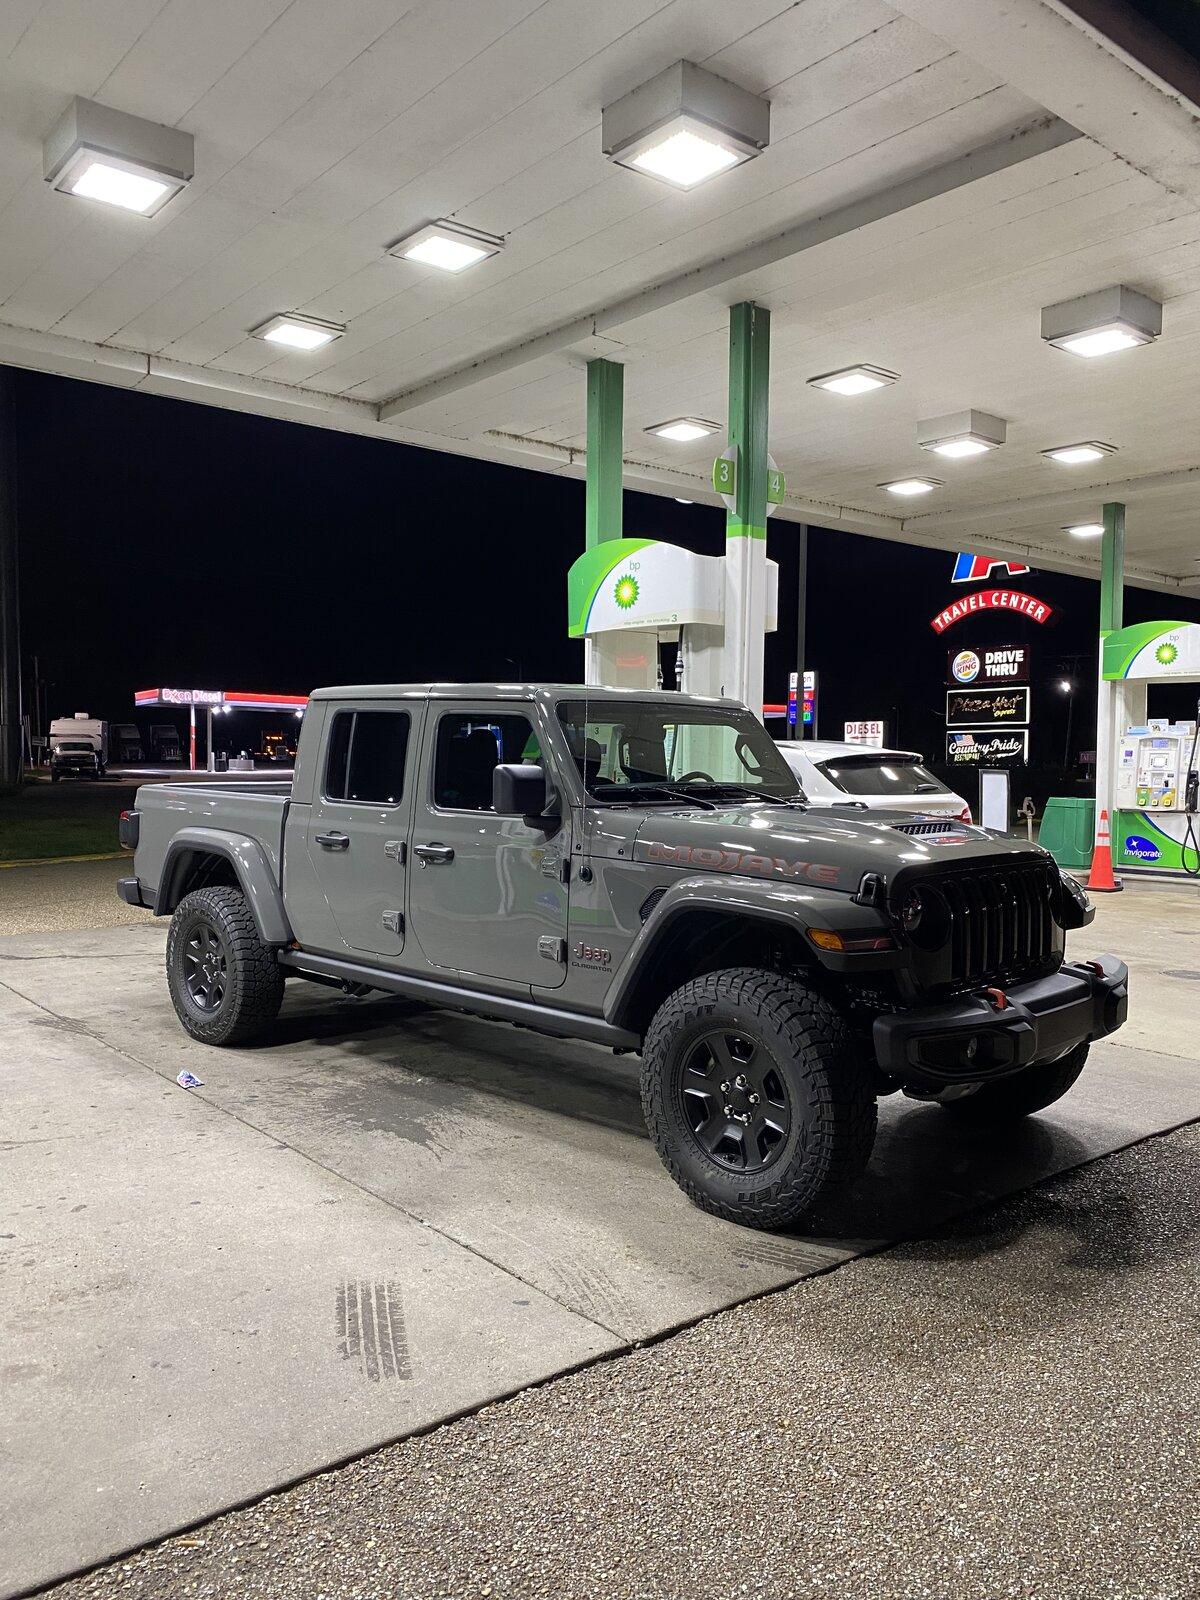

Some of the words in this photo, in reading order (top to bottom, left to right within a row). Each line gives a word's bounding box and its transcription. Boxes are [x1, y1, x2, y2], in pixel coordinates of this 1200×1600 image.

[720, 463, 729, 482] 3
[772, 475, 780, 493] 4
[629, 560, 641, 572] bp
[935, 595, 986, 629] TRAVEL
[991, 592, 1045, 620] CENTER
[671, 613, 678, 623] 3
[1169, 634, 1180, 643] bp
[985, 650, 1024, 664] DRIVE
[956, 662, 977, 674] KING
[985, 663, 1018, 677] THRU
[162, 689, 192, 703] Exxon
[594, 727, 600, 735] 3
[846, 723, 881, 735] DIESEL
[949, 742, 989, 756] Country
[989, 738, 1022, 751] Pride
[648, 842, 841, 883] MOJAVE
[573, 941, 612, 966] Jeep
[571, 961, 612, 973] GLADIATOR
